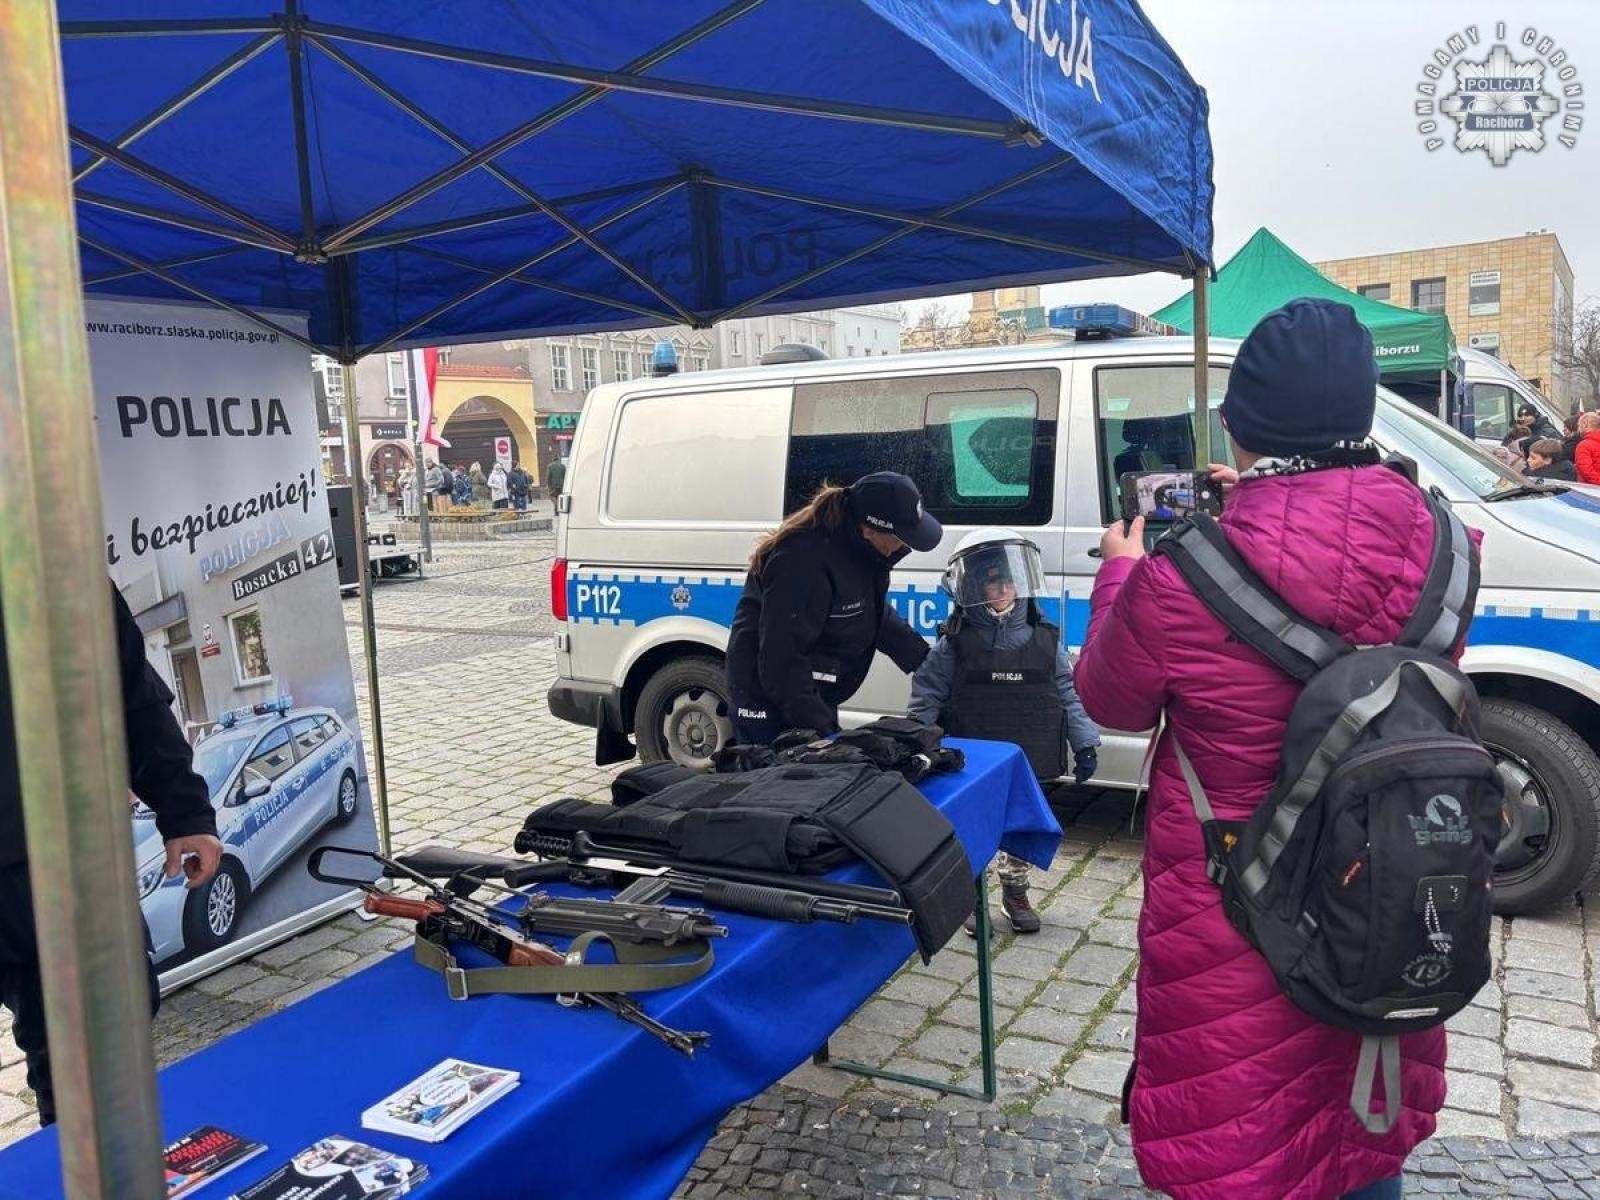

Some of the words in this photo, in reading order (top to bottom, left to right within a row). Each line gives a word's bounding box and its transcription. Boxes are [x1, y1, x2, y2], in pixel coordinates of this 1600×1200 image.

[86, 321, 280, 343] ww.raciborz.slaska.policja.gov.pl
[1375, 344, 1420, 357] iborzu
[116, 395, 292, 438] POLICJA
[131, 467, 318, 556] bezpieczniej!
[232, 559, 300, 599] Bosacka
[304, 535, 333, 566] 42
[576, 584, 621, 614] P112
[991, 672, 1024, 681] POLICJA
[738, 708, 767, 719] POLICJA
[254, 792, 289, 827] POLICJA
